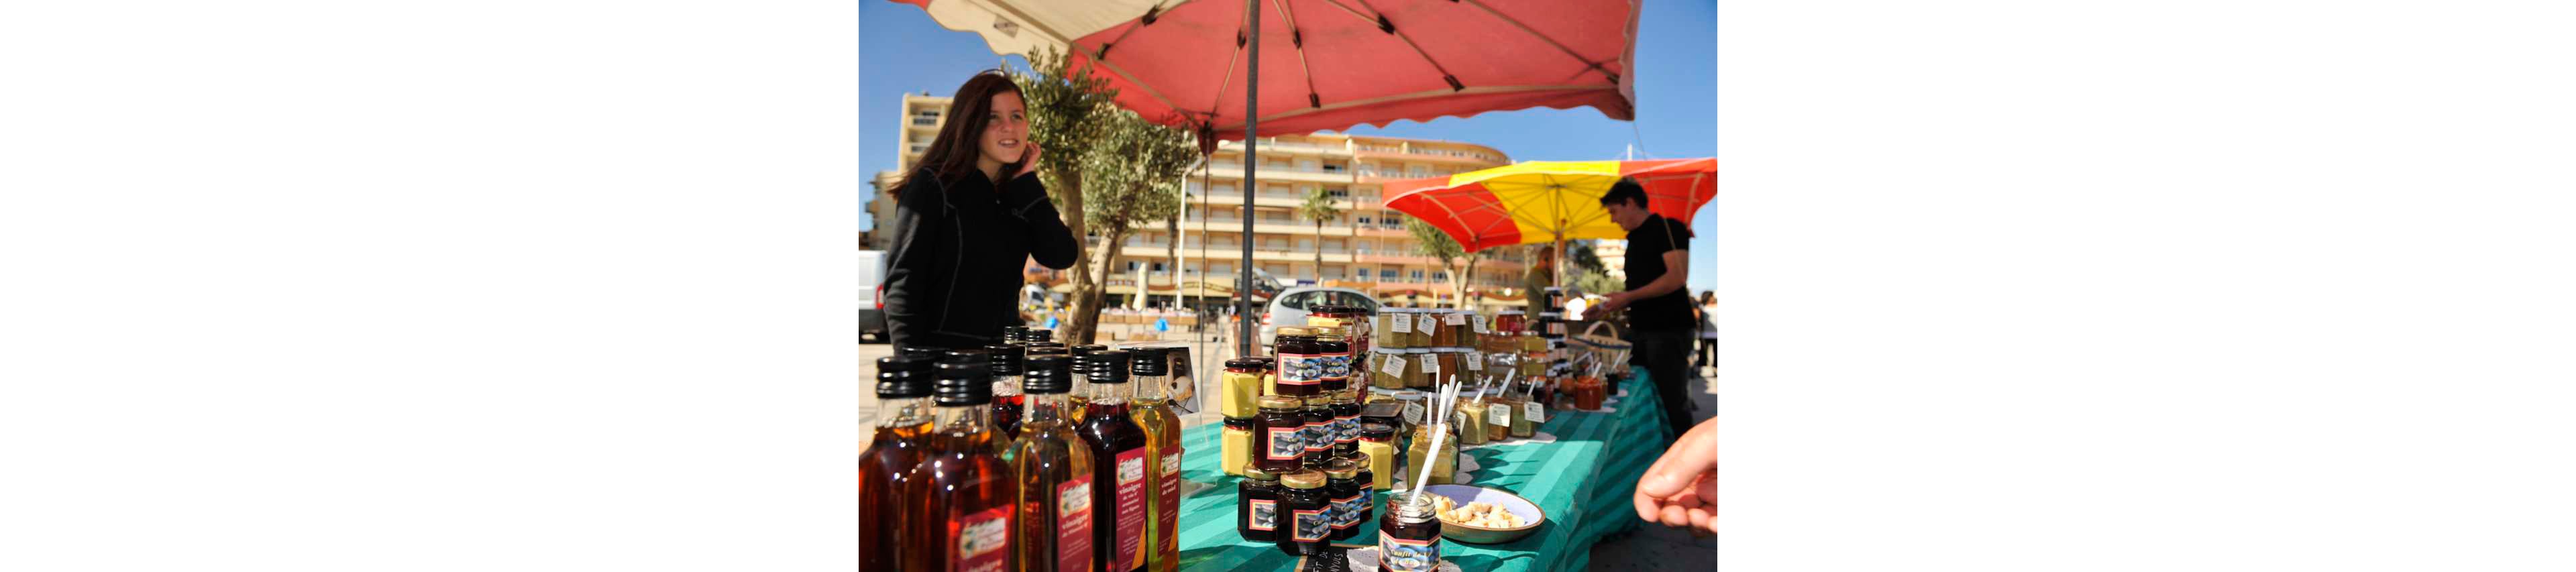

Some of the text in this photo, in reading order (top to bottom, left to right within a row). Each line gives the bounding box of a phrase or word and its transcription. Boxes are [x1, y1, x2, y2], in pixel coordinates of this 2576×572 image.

[1161, 477, 1177, 488] vinaigre
[1119, 483, 1142, 495] vinaigre
[1062, 514, 1087, 530] vinaigre
[1391, 549, 1411, 558] Confit
